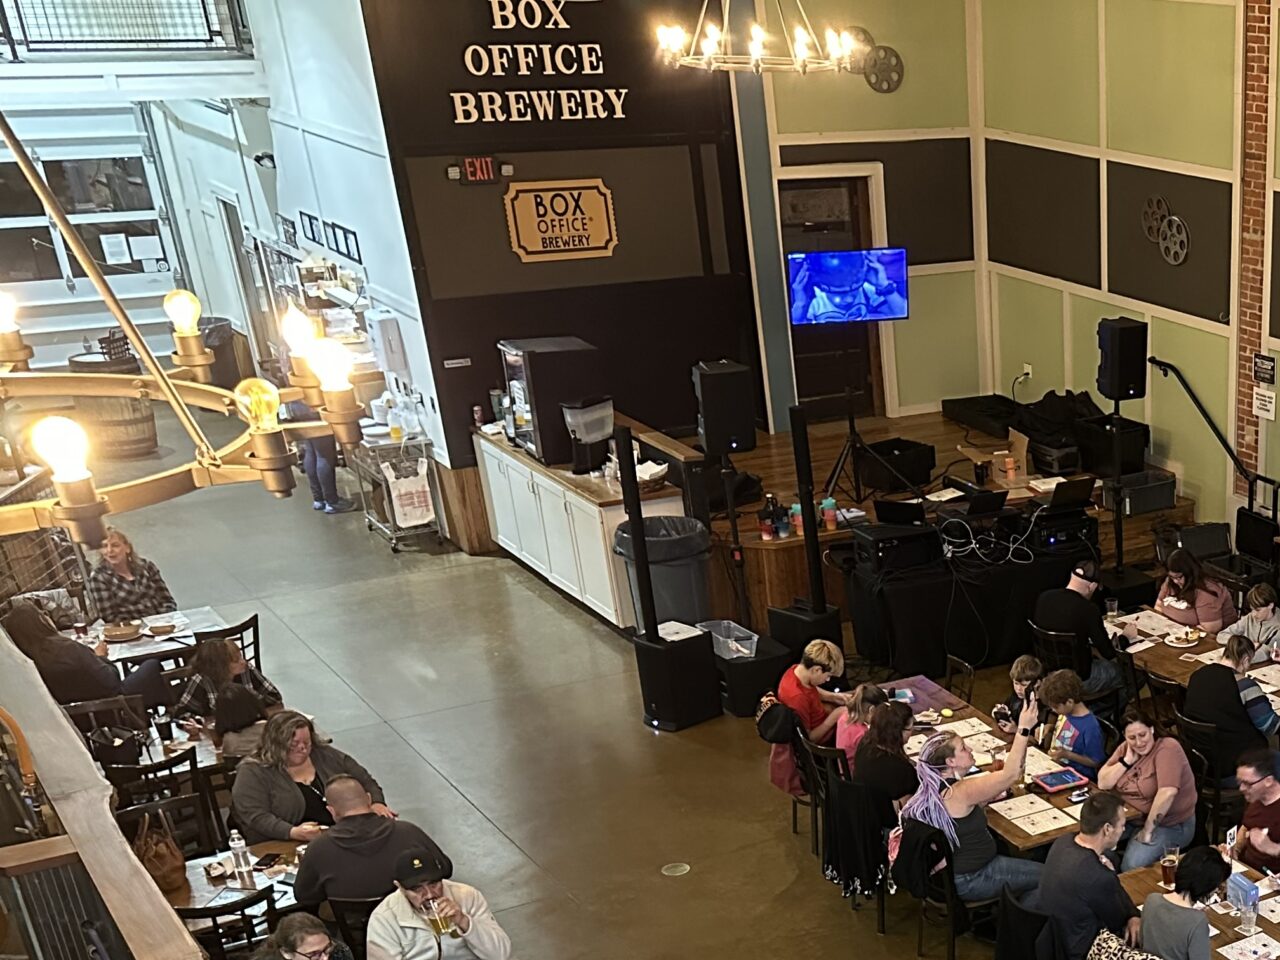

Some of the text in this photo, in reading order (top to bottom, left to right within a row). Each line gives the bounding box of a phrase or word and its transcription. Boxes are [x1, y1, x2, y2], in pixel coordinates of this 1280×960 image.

[489, 0, 570, 29] BOX
[464, 43, 604, 76] OFFICE
[449, 89, 628, 123] BREWERY
[464, 156, 494, 181] EXIT
[533, 191, 586, 219] BOX
[537, 217, 589, 234] OFFICE
[541, 234, 591, 249] BREWERY
